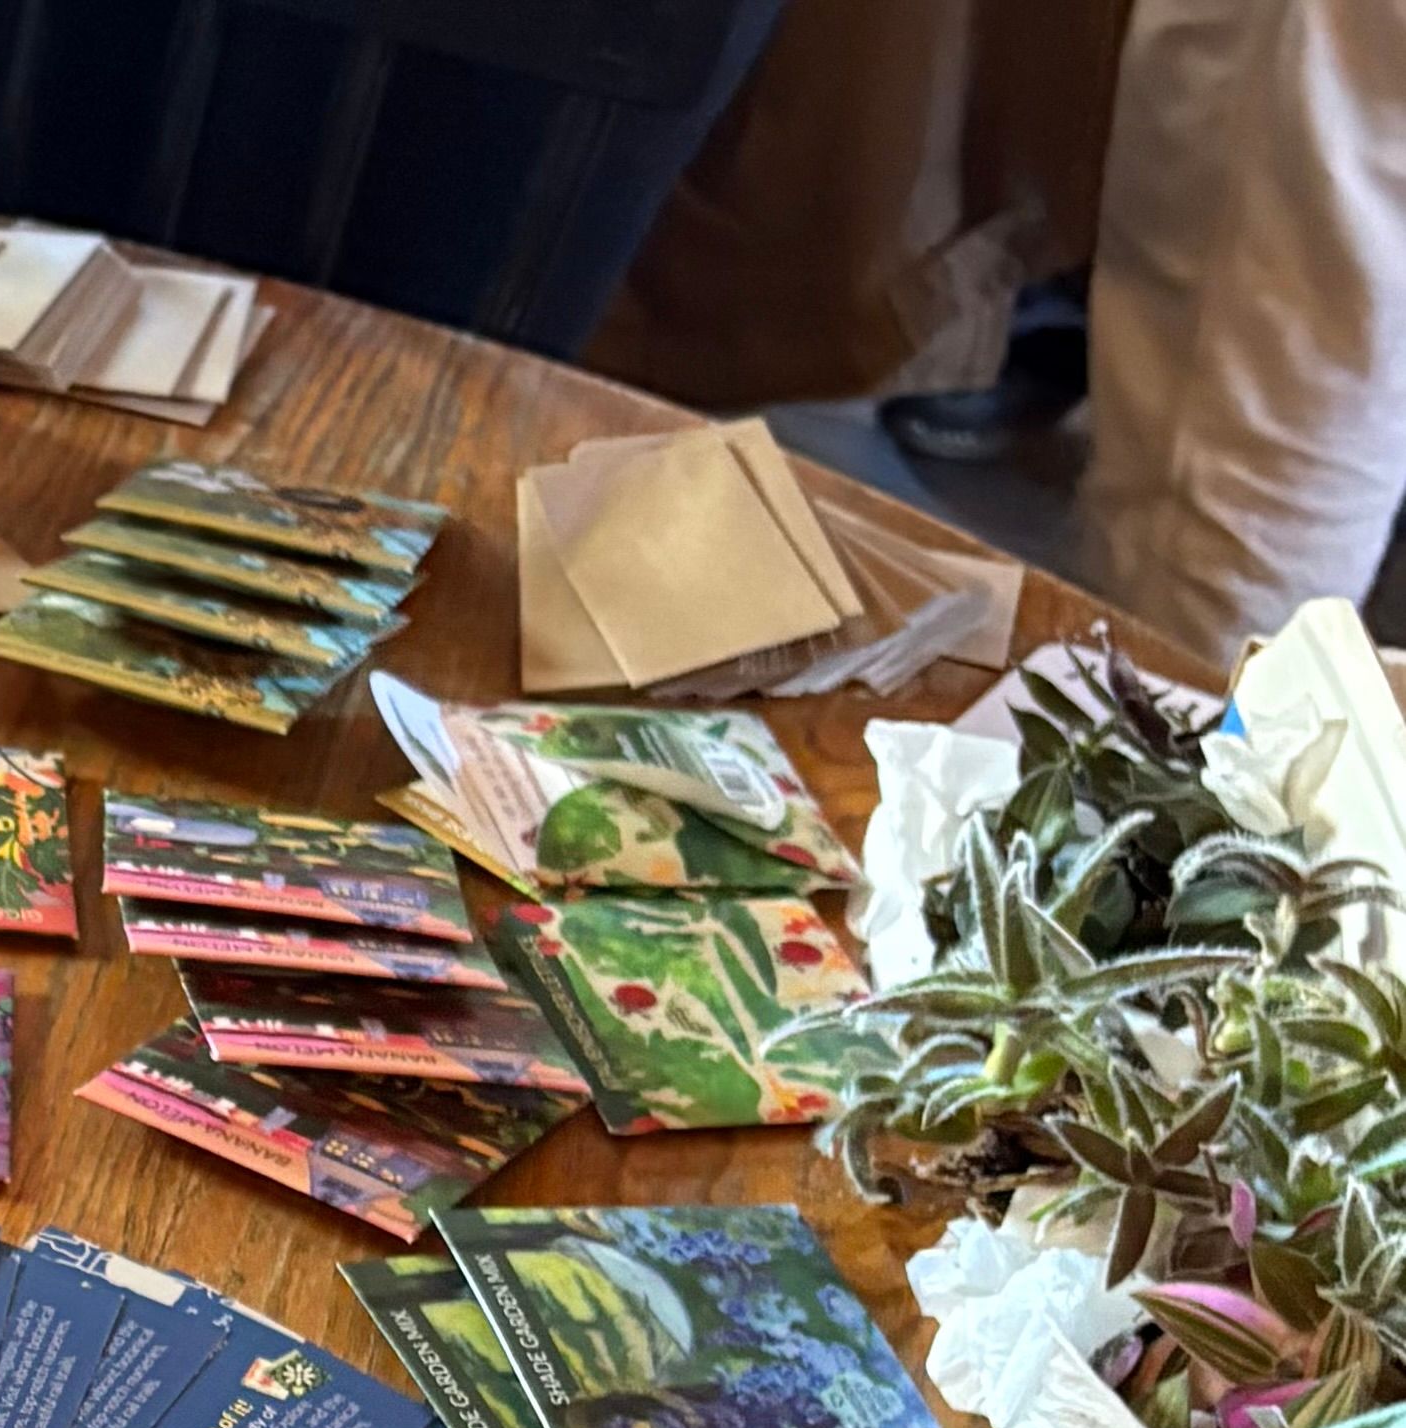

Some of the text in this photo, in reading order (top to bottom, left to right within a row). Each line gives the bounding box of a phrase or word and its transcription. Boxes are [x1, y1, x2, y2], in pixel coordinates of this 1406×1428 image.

[254, 1041, 437, 1065] BANANA MELON
[129, 1091, 292, 1167] BANANA MELON
[389, 1307, 424, 1341] MIX
[474, 1253, 571, 1406] SHADE GARDEN MIX
[412, 1341, 470, 1408] GARDEN
[229, 1398, 254, 1419] it!
[261, 1403, 279, 1420] of
